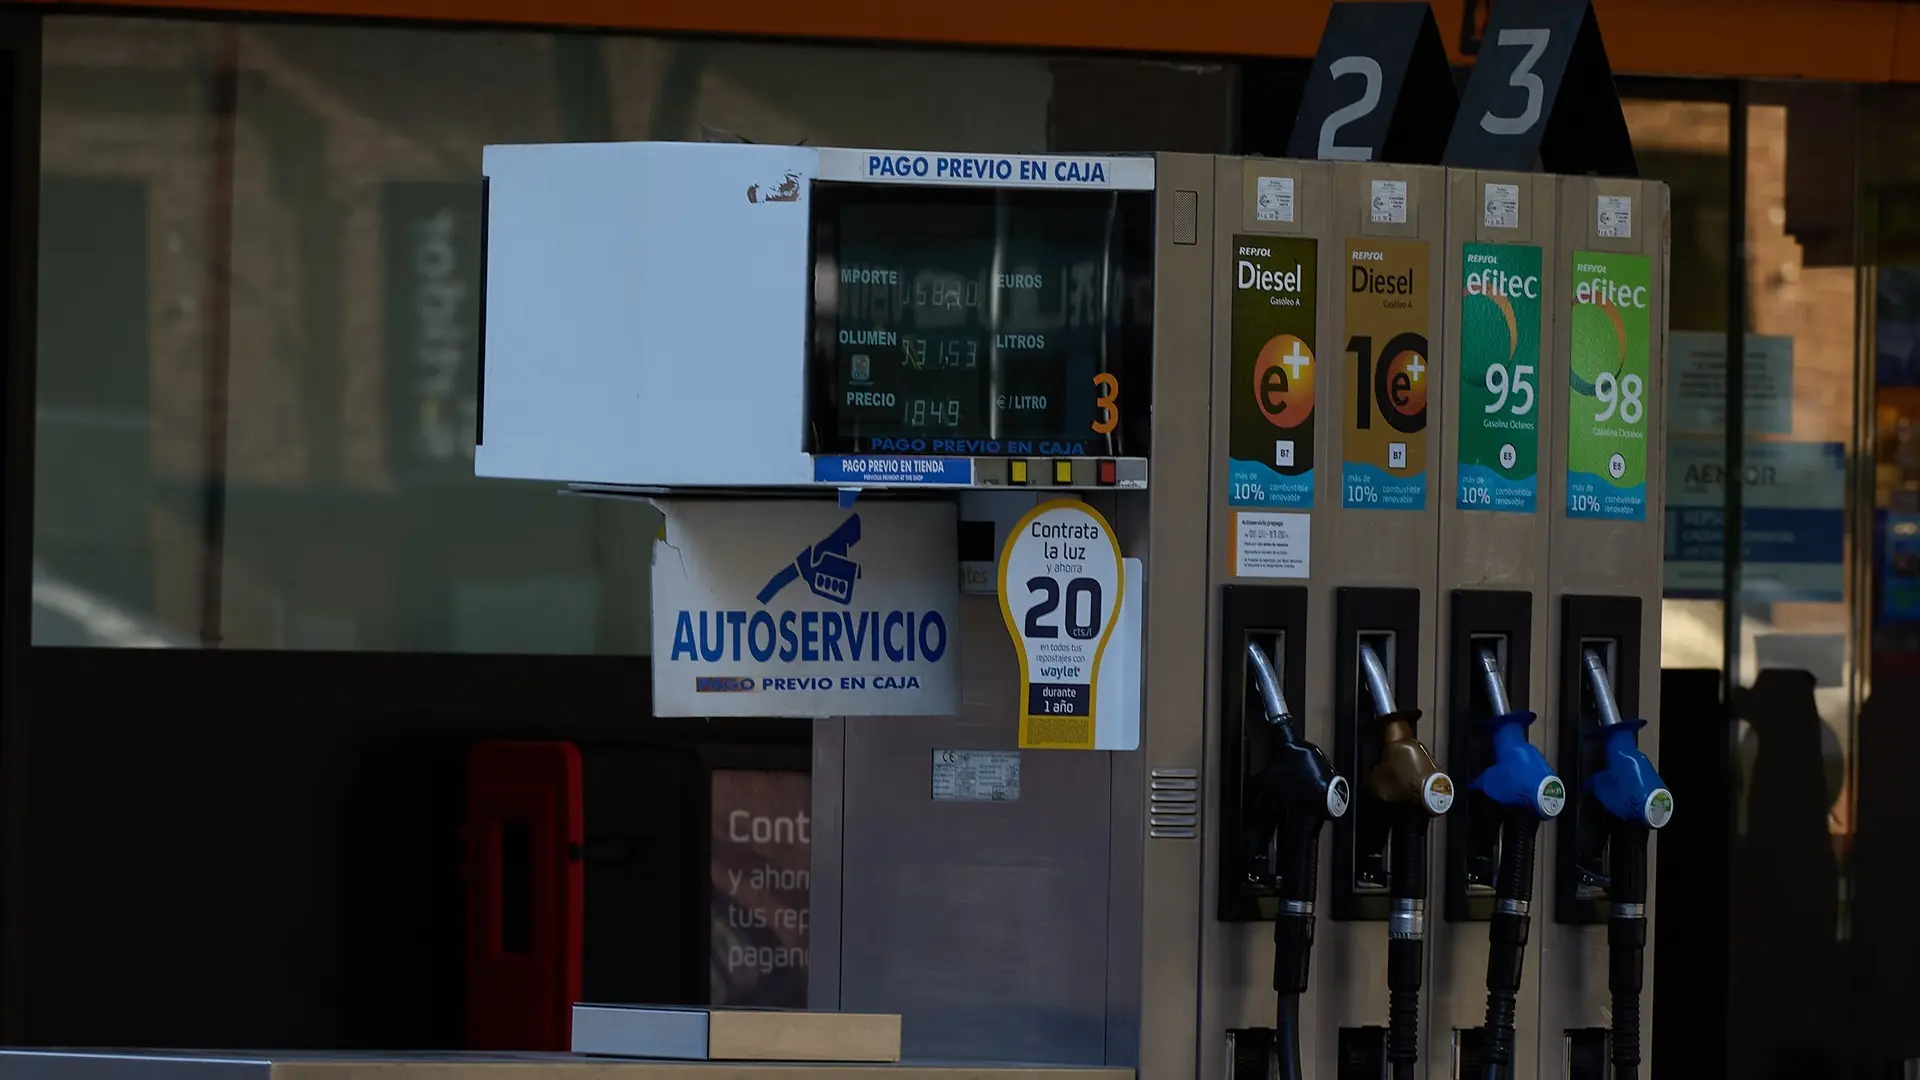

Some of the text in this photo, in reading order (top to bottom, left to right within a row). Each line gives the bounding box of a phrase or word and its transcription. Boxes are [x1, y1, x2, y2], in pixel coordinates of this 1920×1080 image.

[1480, 28, 1551, 135] 3
[1317, 55, 1383, 161] 2
[869, 156, 1105, 182] PAGO PREVIO EN CAJA
[1239, 246, 1272, 257] REPSOL
[1352, 250, 1384, 261] REPSOL
[1467, 254, 1499, 265] REPSOL
[998, 273, 1043, 289] EUROS
[1237, 260, 1301, 292] Diesel
[1352, 265, 1413, 295] Diesel
[1466, 268, 1537, 299] efitec
[1576, 278, 1646, 309] efitec
[996, 334, 1045, 349] LITROS
[1484, 362, 1534, 416] 95
[1594, 371, 1643, 424] 98
[846, 391, 896, 407] PRECIO
[1091, 372, 1119, 434] 3
[1483, 419, 1509, 429] Gasolina
[870, 437, 1085, 455] PAGO PREVIO EN CAJA
[842, 459, 945, 473] PAGO PREVIO EN TIENDA
[1234, 483, 1265, 500] 10%
[1348, 485, 1378, 503] 10%
[1462, 486, 1491, 505] 10%
[1571, 494, 1600, 512] 10%
[1031, 521, 1099, 540] Contrata
[1044, 541, 1086, 561] la luz
[1054, 562, 1083, 573] ahorra
[1024, 576, 1102, 640] 20
[670, 610, 947, 663] AUTOSERVICIO
[1050, 643, 1070, 652] todos
[1071, 644, 1082, 652] tus
[1035, 654, 1072, 664] repostajes
[698, 676, 920, 691] PAGO PREVIO EN CAJA
[1042, 687, 1077, 698] durante
[1044, 700, 1073, 713] 1 año
[729, 809, 810, 844] Cont
[728, 867, 743, 895] y
[728, 903, 768, 928] tus
